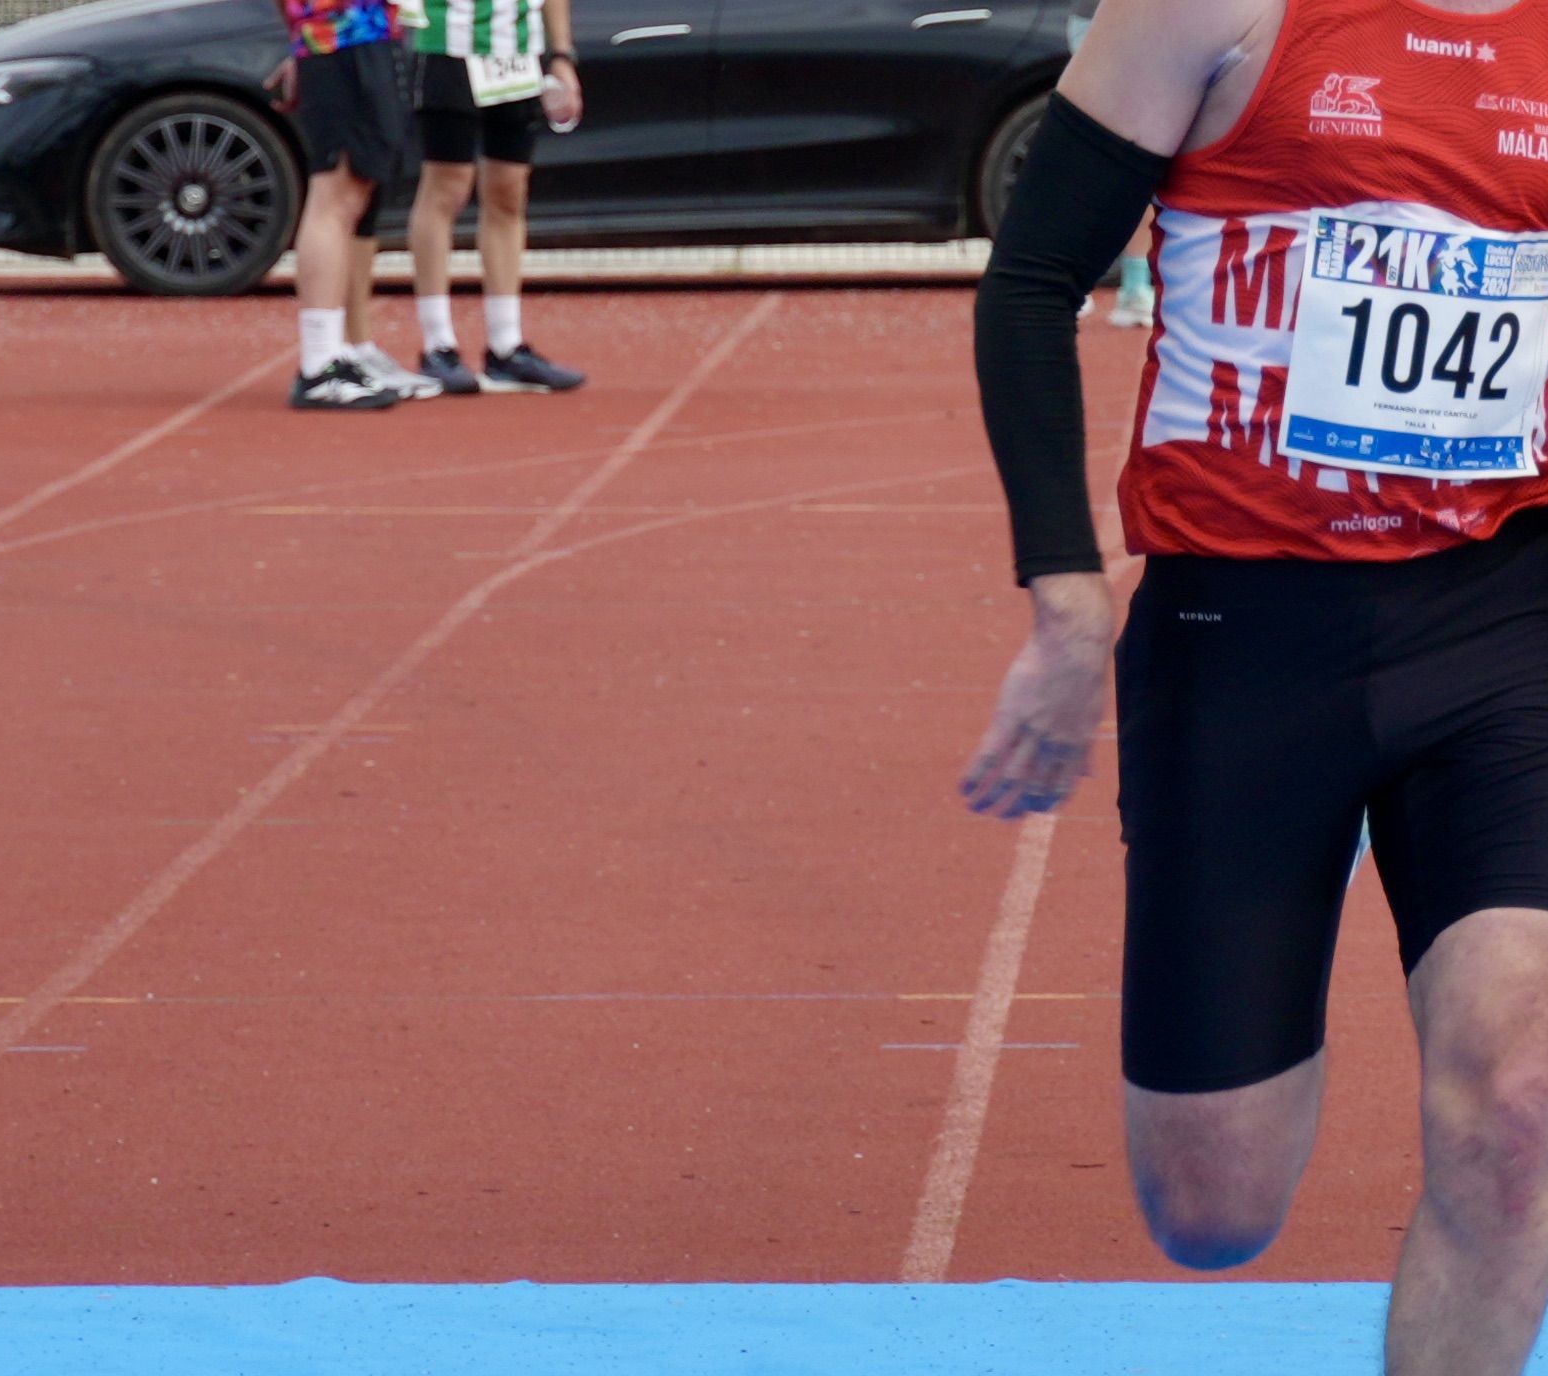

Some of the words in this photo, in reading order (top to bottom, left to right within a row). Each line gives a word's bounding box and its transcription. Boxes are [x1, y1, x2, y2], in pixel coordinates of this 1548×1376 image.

[1406, 32, 1472, 59] luanvi
[1309, 120, 1382, 138] GENERALI
[1345, 224, 1437, 292] 21K
[1341, 297, 1521, 401] 1042
